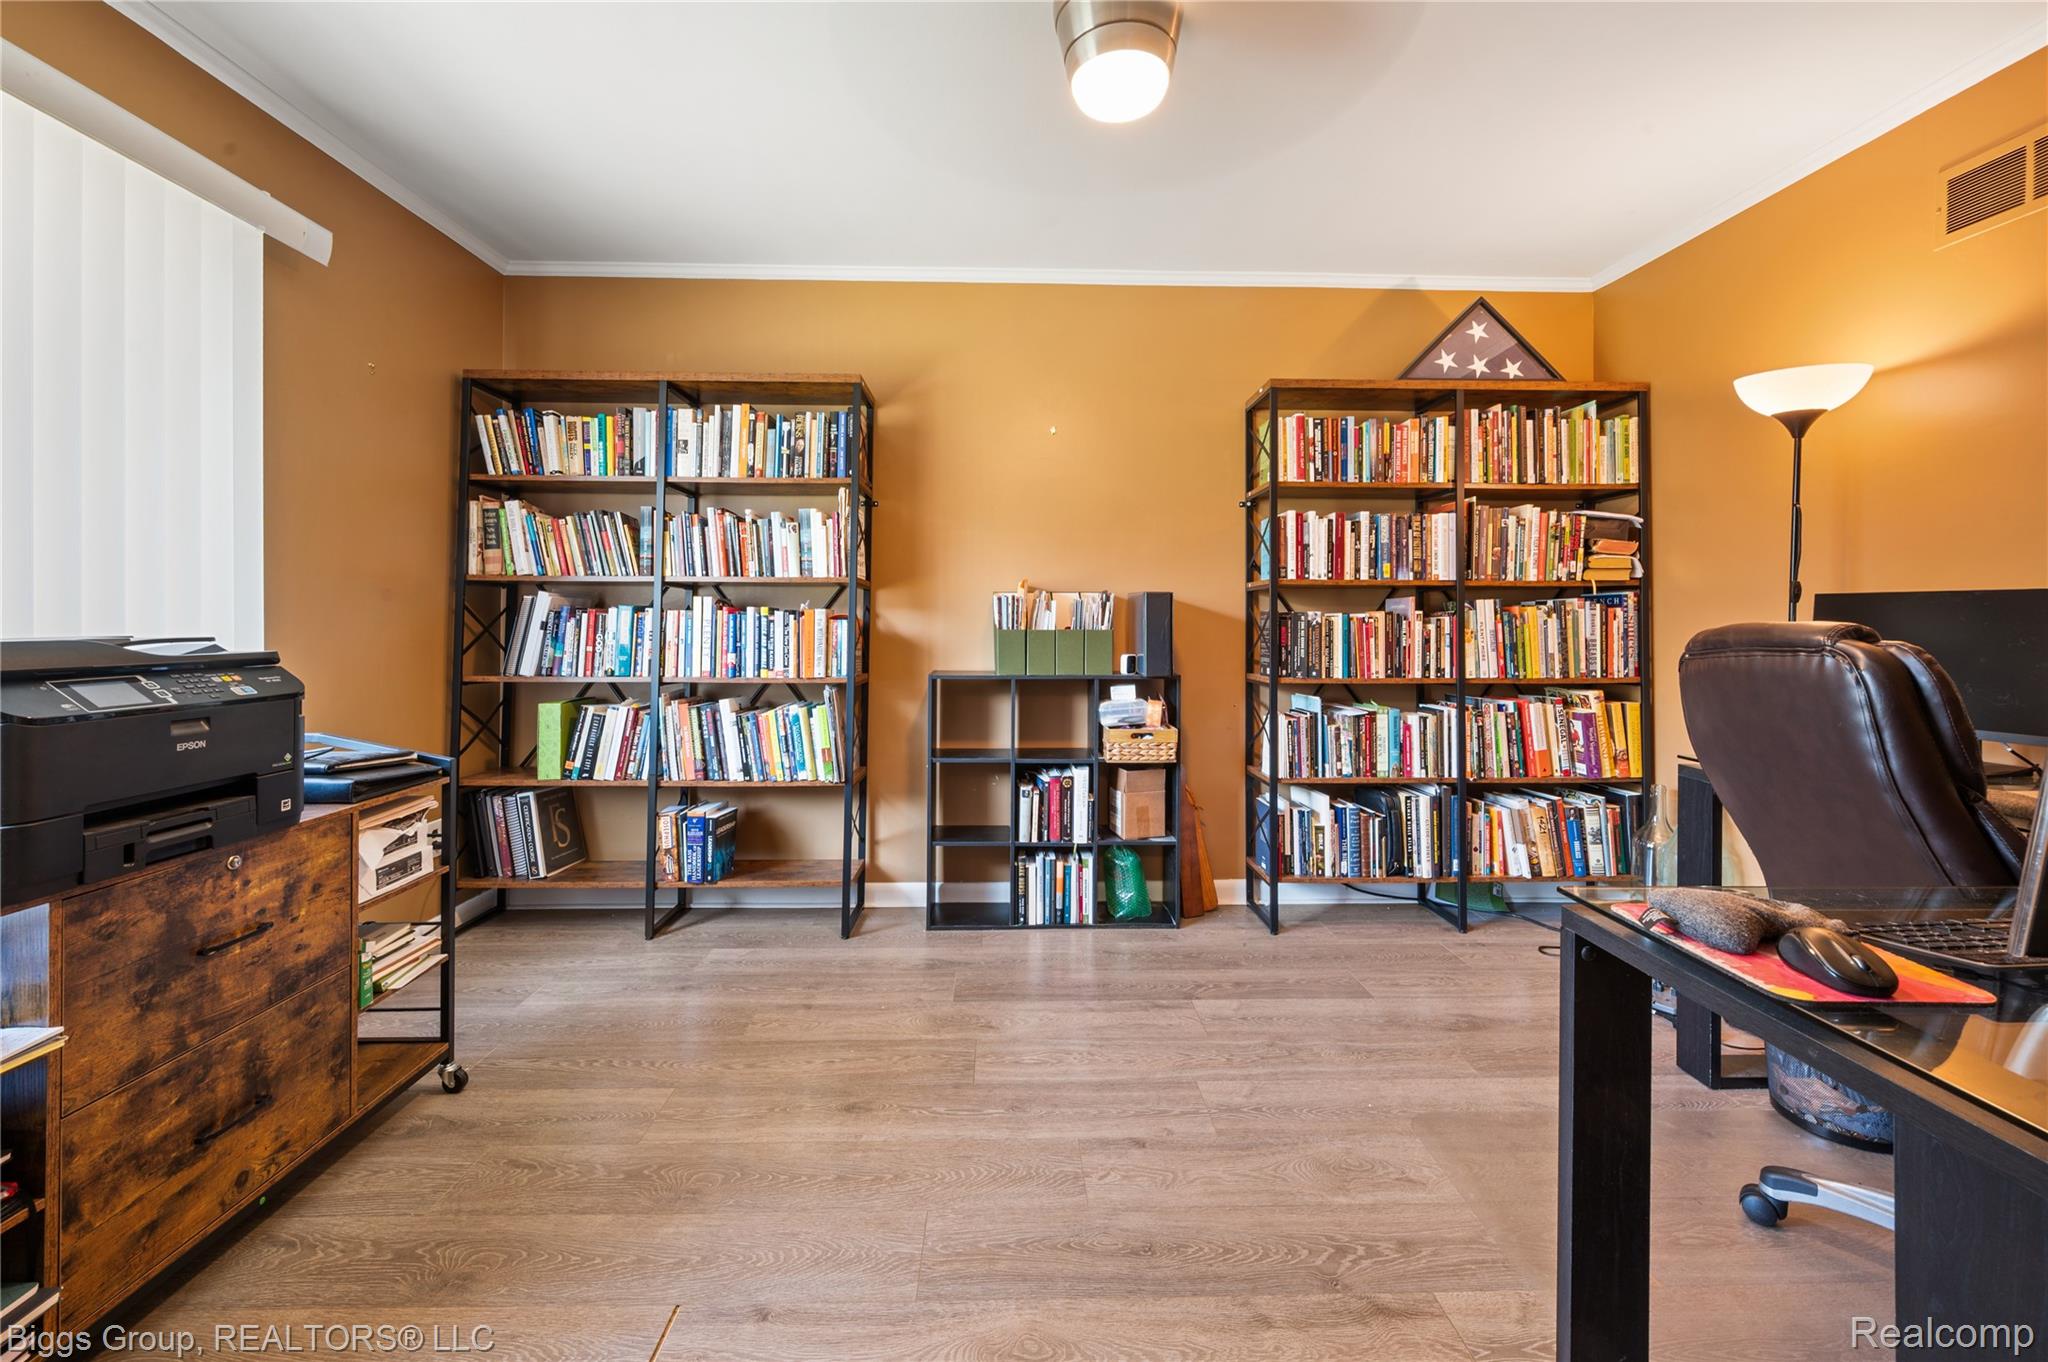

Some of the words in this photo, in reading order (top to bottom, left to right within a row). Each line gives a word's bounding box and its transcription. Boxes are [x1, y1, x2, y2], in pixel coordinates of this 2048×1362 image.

[568, 421, 577, 441] ROOTS
[1589, 639, 1597, 666] BREADS
[1557, 709, 1566, 744] SENEGAL
[1597, 714, 1608, 759] THAILAND
[176, 740, 207, 752] EPSON
[522, 805, 533, 842] CERTIFICATION
[528, 842, 537, 863] COURSE
[661, 816, 671, 849] JOSEPHUS
